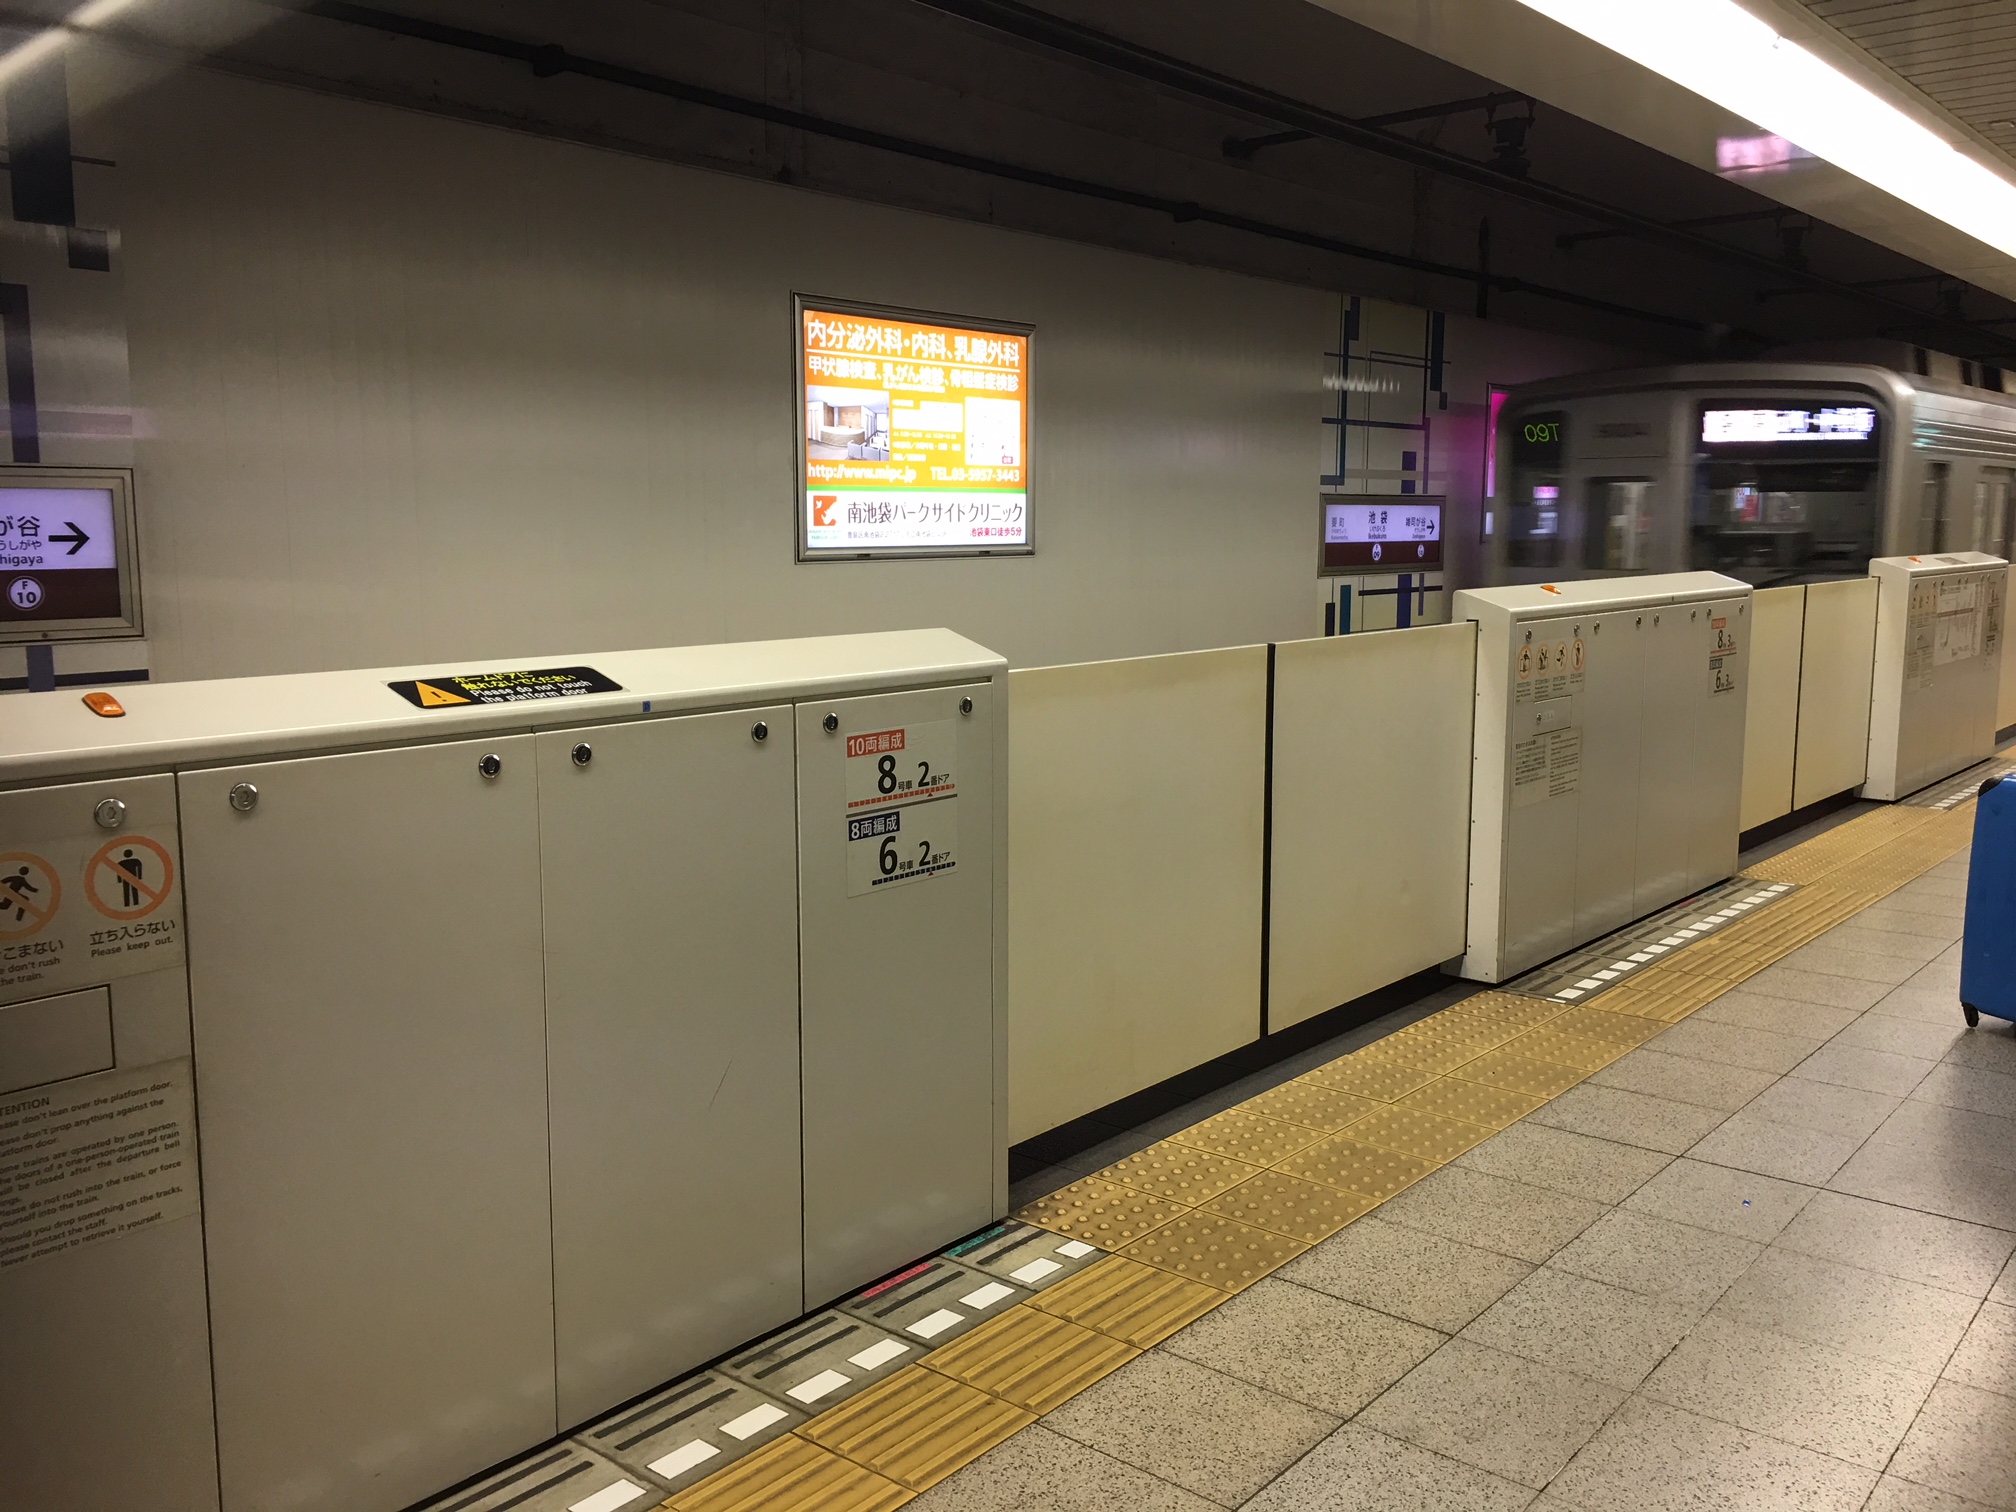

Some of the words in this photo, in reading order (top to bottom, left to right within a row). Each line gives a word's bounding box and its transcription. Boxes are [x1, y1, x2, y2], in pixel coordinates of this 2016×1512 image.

[846, 501, 1024, 525] 南池袋パークサイドクリニック
[969, 526, 1023, 538] 池袋東口徒歩5分
[22, 580, 29, 590] F
[16, 591, 37, 604] 10
[470, 687, 515, 697] Please
[516, 685, 533, 694] do
[535, 683, 557, 692] not
[557, 680, 593, 689] touch
[480, 696, 505, 704] the
[506, 691, 561, 702] platform
[562, 688, 589, 697] door
[848, 731, 904, 756] 10両編成
[850, 813, 899, 840] 8両編成
[89, 919, 176, 947] 立ち入らない
[0, 939, 65, 961] こまない
[90, 944, 123, 959] Please
[126, 940, 151, 952] keep
[154, 935, 174, 945] out.
[7, 960, 36, 973] don't
[38, 956, 61, 969] rush
[0, 976, 15, 987] he
[17, 971, 45, 983] train.
[22, 1111, 47, 1124] don't
[49, 1107, 69, 1118] lean
[70, 1102, 92, 1112] over
[93, 1096, 109, 1107] the
[110, 1086, 149, 1104] platform
[150, 1080, 174, 1093] door.
[23, 1128, 49, 1141] don't
[50, 1122, 73, 1135] prop
[74, 1110, 115, 1129] anything
[116, 1102, 149, 1116] against
[150, 1098, 165, 1108] the
[15, 1169, 41, 1182] doors
[159, 1130, 181, 1142] train
[23, 1156, 50, 1168] trains
[53, 1150, 68, 1160] are
[70, 1138, 111, 1156] operated
[113, 1134, 126, 1145] by
[128, 1130, 145, 1140] one
[18, 1182, 30, 1191] be
[35, 1172, 66, 1187] closed
[69, 1164, 93, 1178] after
[96, 1160, 113, 1171] the
[116, 1145, 161, 1165] departure
[163, 1139, 181, 1151] bell
[29, 1200, 42, 1210] do
[44, 1195, 61, 1205] not
[62, 1187, 84, 1200] rush
[85, 1181, 104, 1194] into
[105, 1177, 121, 1188] the
[159, 1160, 182, 1173] force
[34, 1226, 52, 1238] you
[53, 1217, 76, 1230] drop
[77, 1203, 125, 1222] something
[125, 1198, 139, 1208] on
[139, 1193, 154, 1204] the
[38, 1207, 57, 1218] into
[59, 1202, 75, 1212] the
[67, 1227, 83, 1237] the
[69, 1238, 81, 1248] to
[82, 1226, 117, 1243] retrieve
